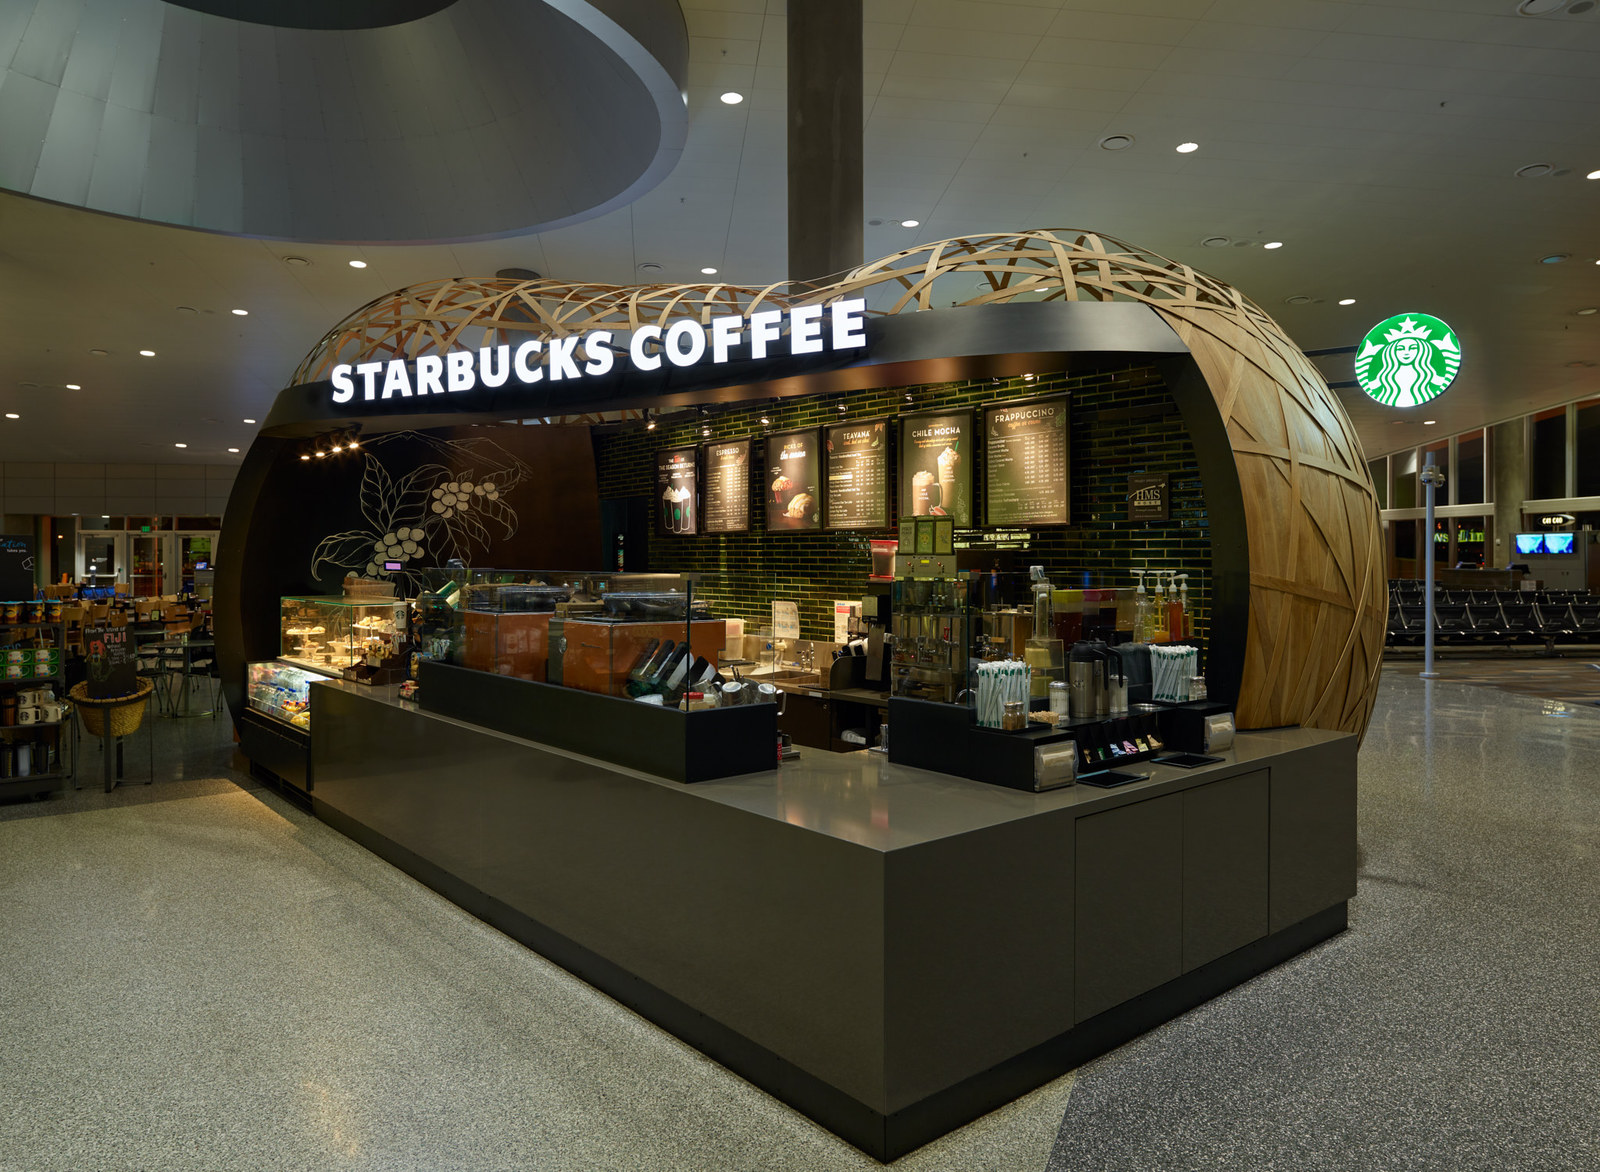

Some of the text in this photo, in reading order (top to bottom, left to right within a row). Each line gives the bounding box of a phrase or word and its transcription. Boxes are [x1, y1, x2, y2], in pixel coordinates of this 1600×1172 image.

[332, 298, 866, 403] STARBUCKS COFFEE
[995, 408, 1054, 423] FRAPPUCCINO
[843, 431, 870, 440] TEAVANA
[911, 427, 961, 437] CHILE MOCHA
[716, 447, 740, 457] ESPRESSO
[1136, 489, 1160, 501] HMS
[104, 631, 127, 643] FIJI
